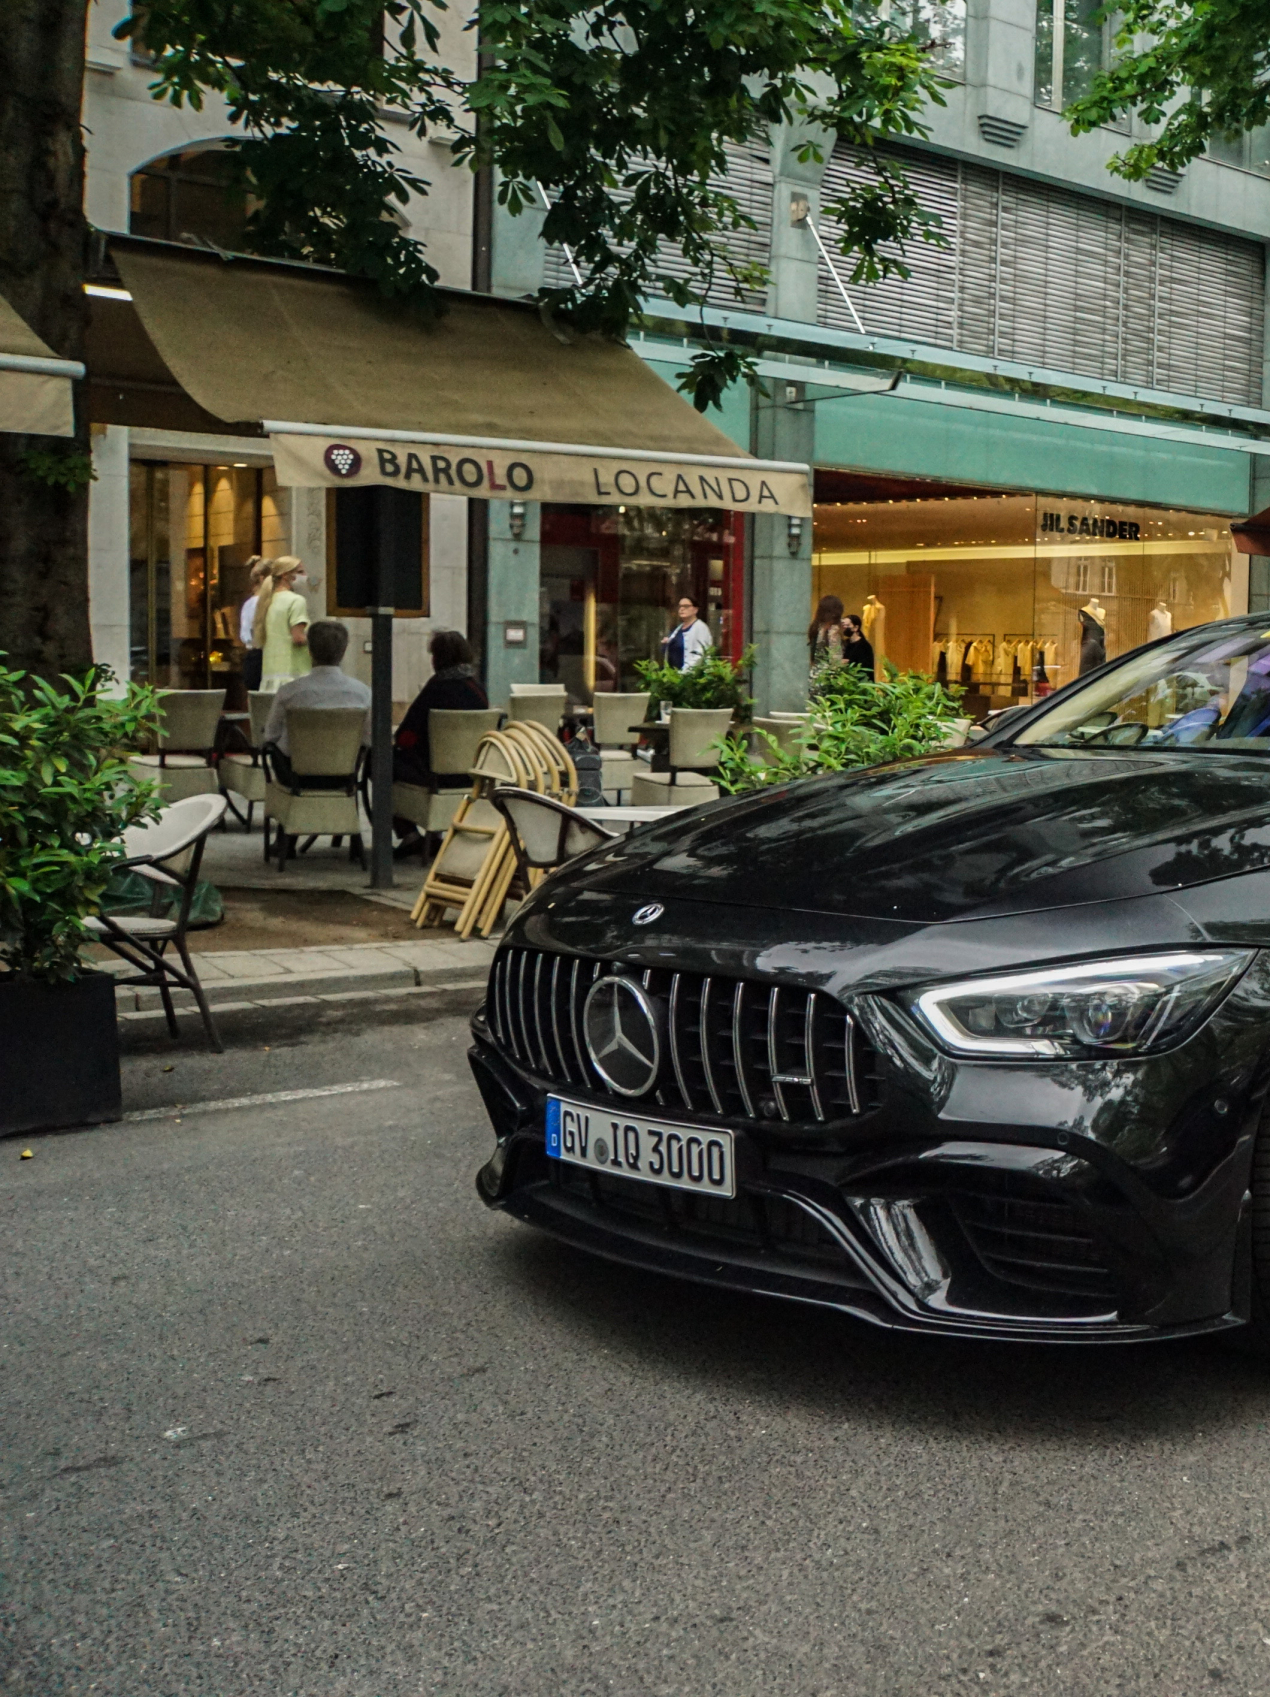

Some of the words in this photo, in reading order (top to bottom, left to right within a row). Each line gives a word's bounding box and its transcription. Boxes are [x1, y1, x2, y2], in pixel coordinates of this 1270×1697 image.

[375, 447, 535, 493] BAROLO
[592, 467, 780, 506] LOCANDA
[1040, 512, 1065, 533] JIL
[1067, 515, 1141, 541] SANDER
[563, 1109, 590, 1159] GV
[610, 1121, 641, 1172] IQ
[648, 1128, 725, 1186] 3000
